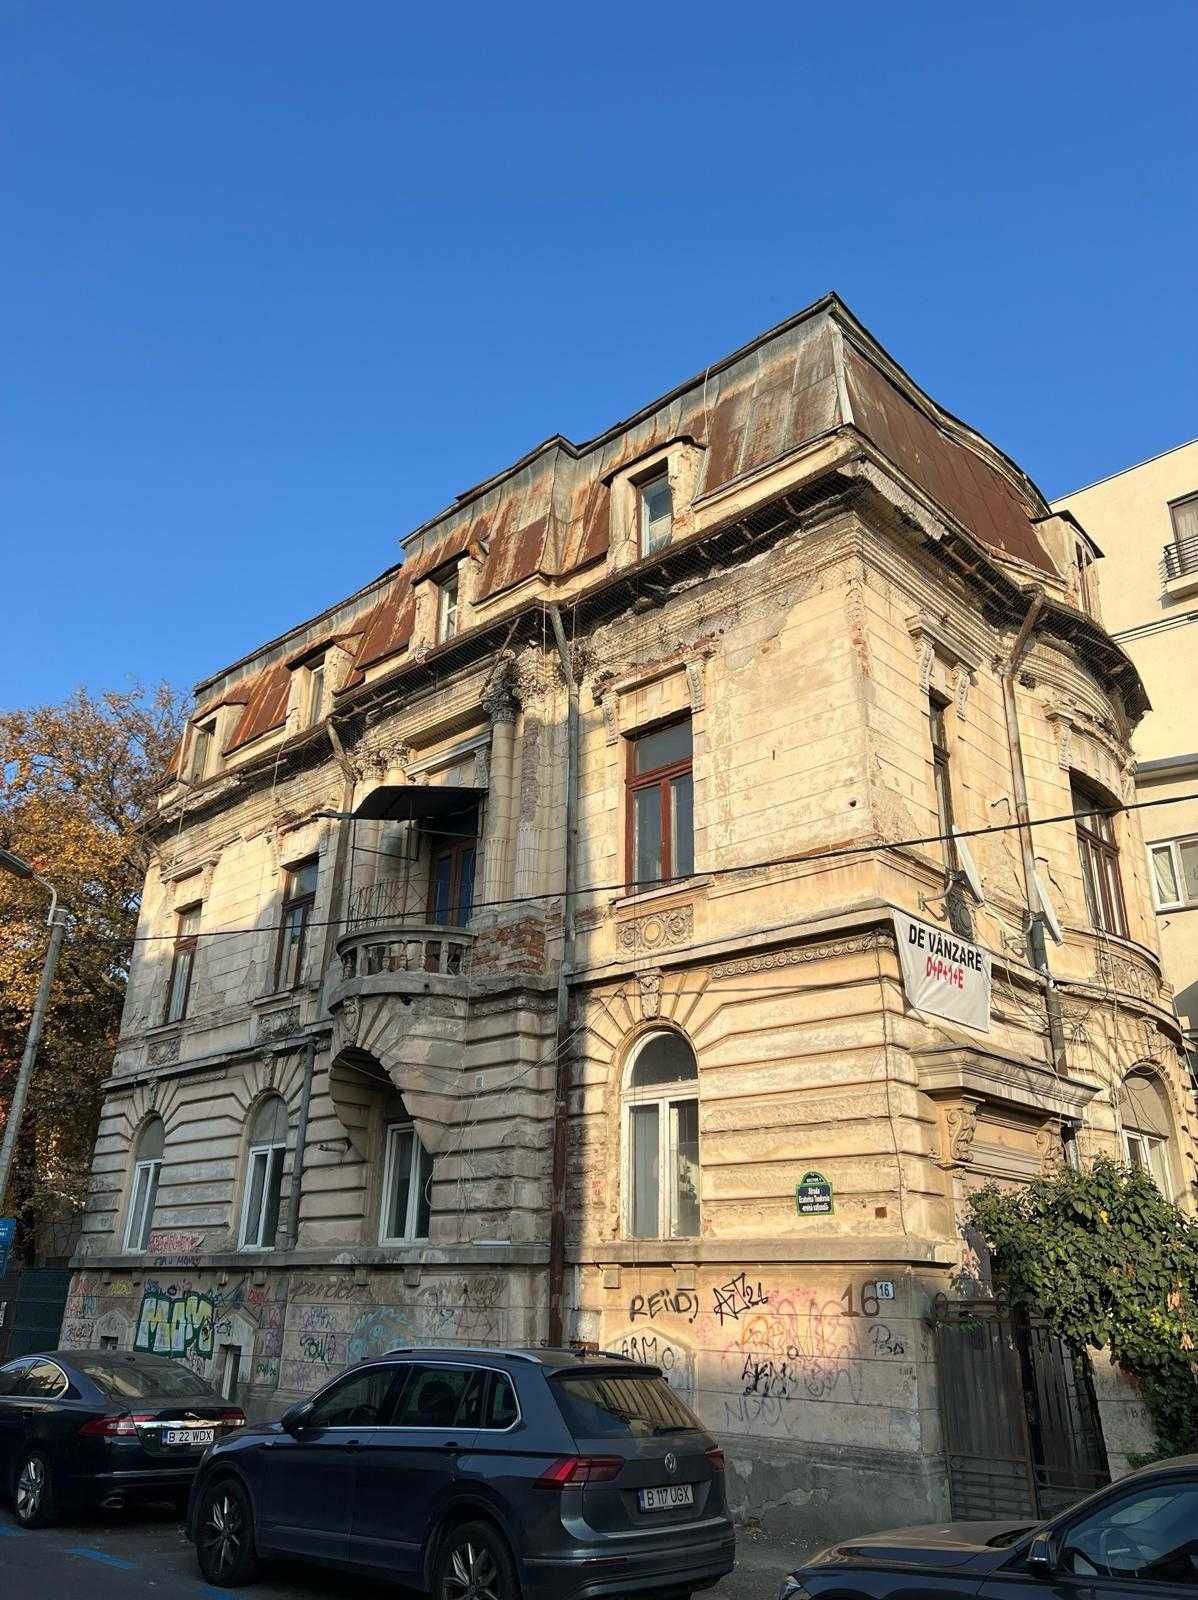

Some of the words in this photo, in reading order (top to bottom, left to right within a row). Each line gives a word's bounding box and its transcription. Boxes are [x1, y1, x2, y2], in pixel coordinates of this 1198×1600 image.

[909, 924, 925, 948] DE
[929, 932, 981, 971] VÂNZARE
[879, 1284, 890, 1297] 16
[169, 1432, 176, 1442] B
[179, 1432, 190, 1441] 22
[193, 1430, 212, 1441] WDX
[647, 1490, 654, 1506] B
[657, 1488, 668, 1504] 117
[670, 1487, 690, 1503] UGX
